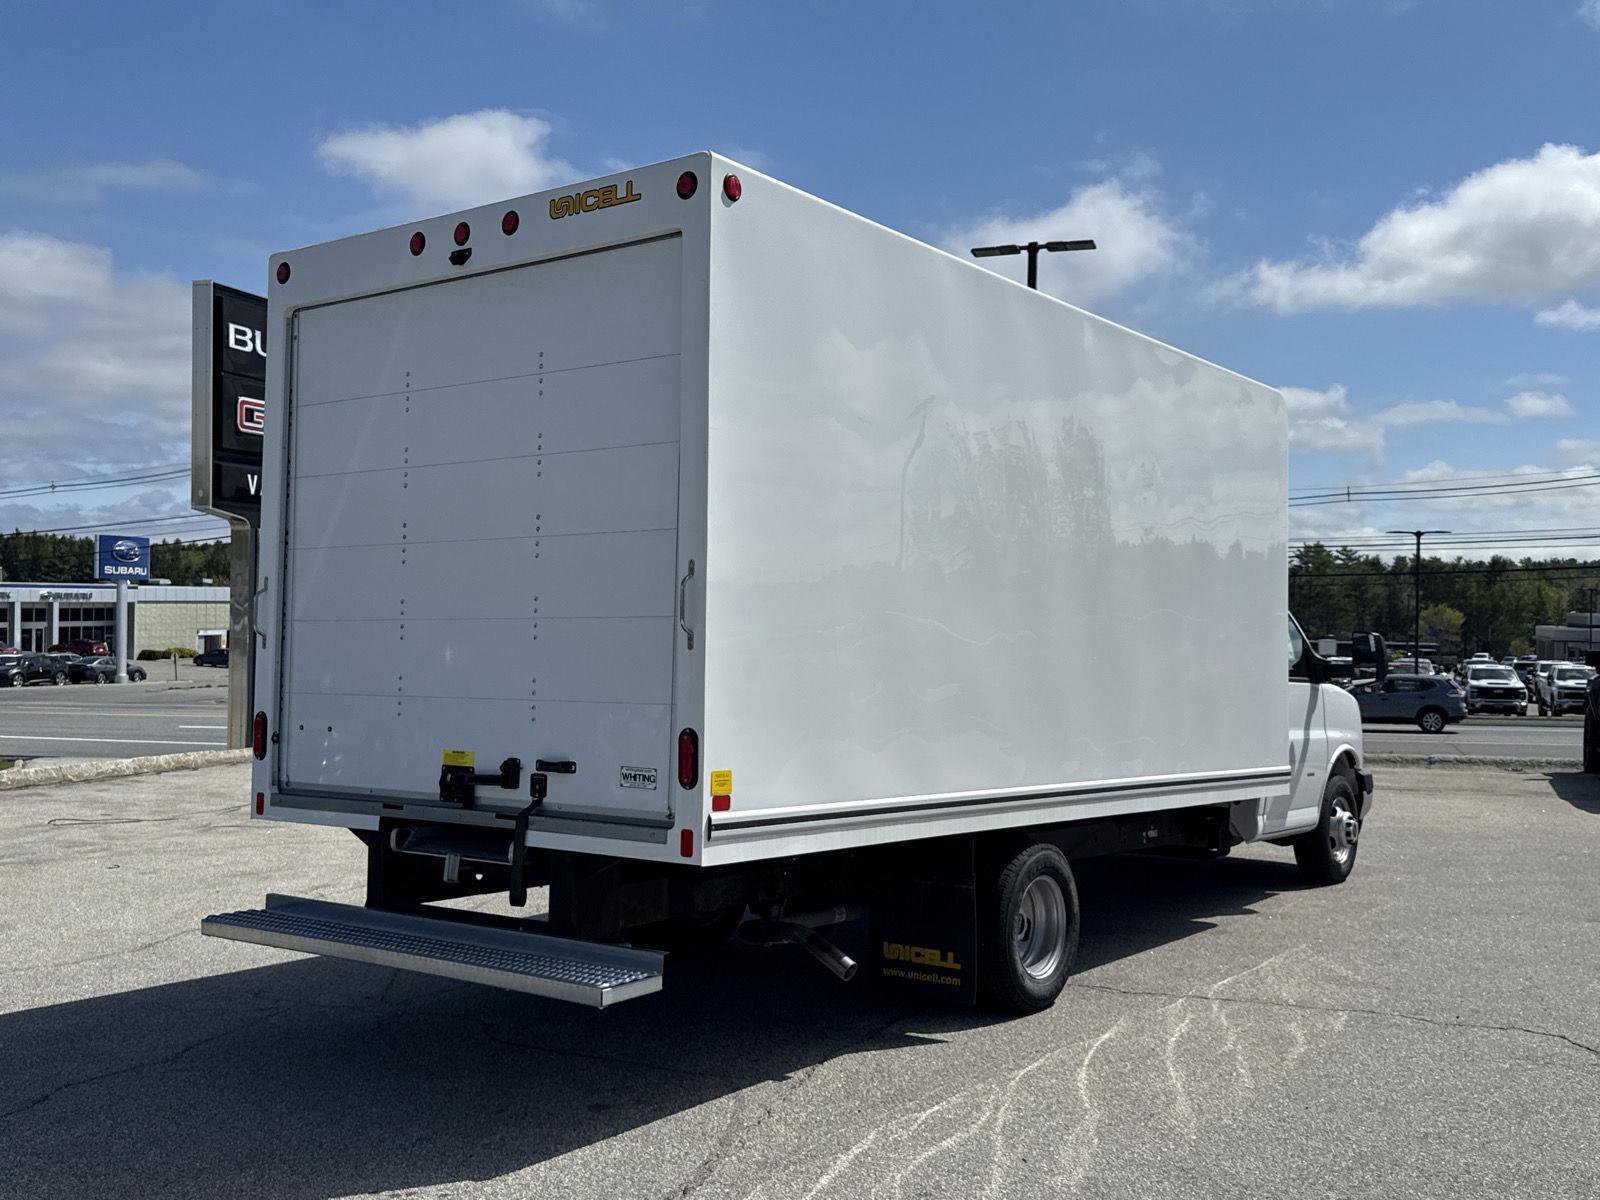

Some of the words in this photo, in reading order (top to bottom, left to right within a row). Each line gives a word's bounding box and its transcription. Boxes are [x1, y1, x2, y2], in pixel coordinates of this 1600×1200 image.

[549, 180, 641, 219] UNICELL
[247, 473, 263, 496] V
[104, 565, 147, 576] SUBARU
[621, 772, 656, 783] WHITING
[882, 941, 961, 970] UNICELL
[882, 968, 961, 986] www.unicell.com
